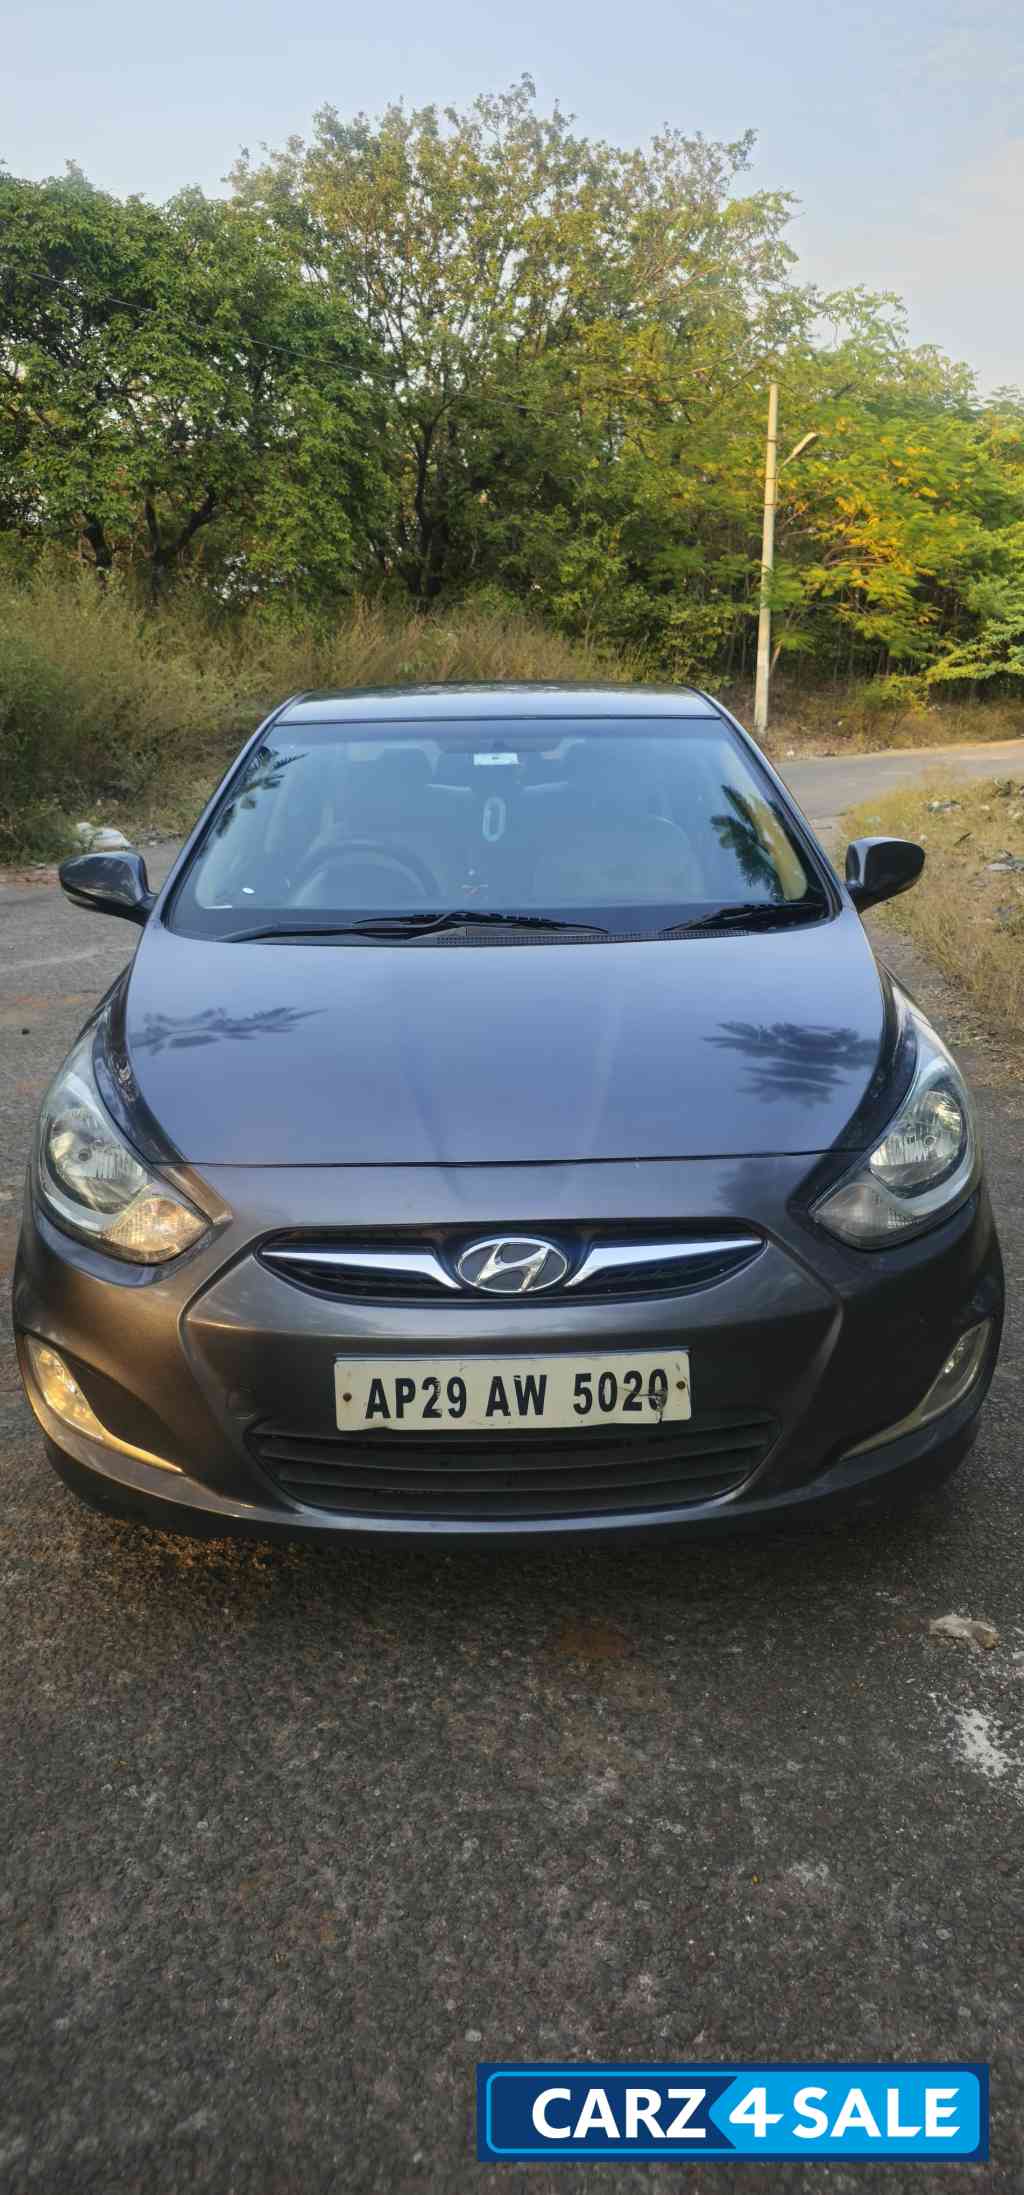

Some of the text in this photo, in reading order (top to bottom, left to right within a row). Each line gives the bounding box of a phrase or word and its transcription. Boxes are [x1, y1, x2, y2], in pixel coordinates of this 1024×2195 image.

[364, 1368, 669, 1419] AP29 AW 5020
